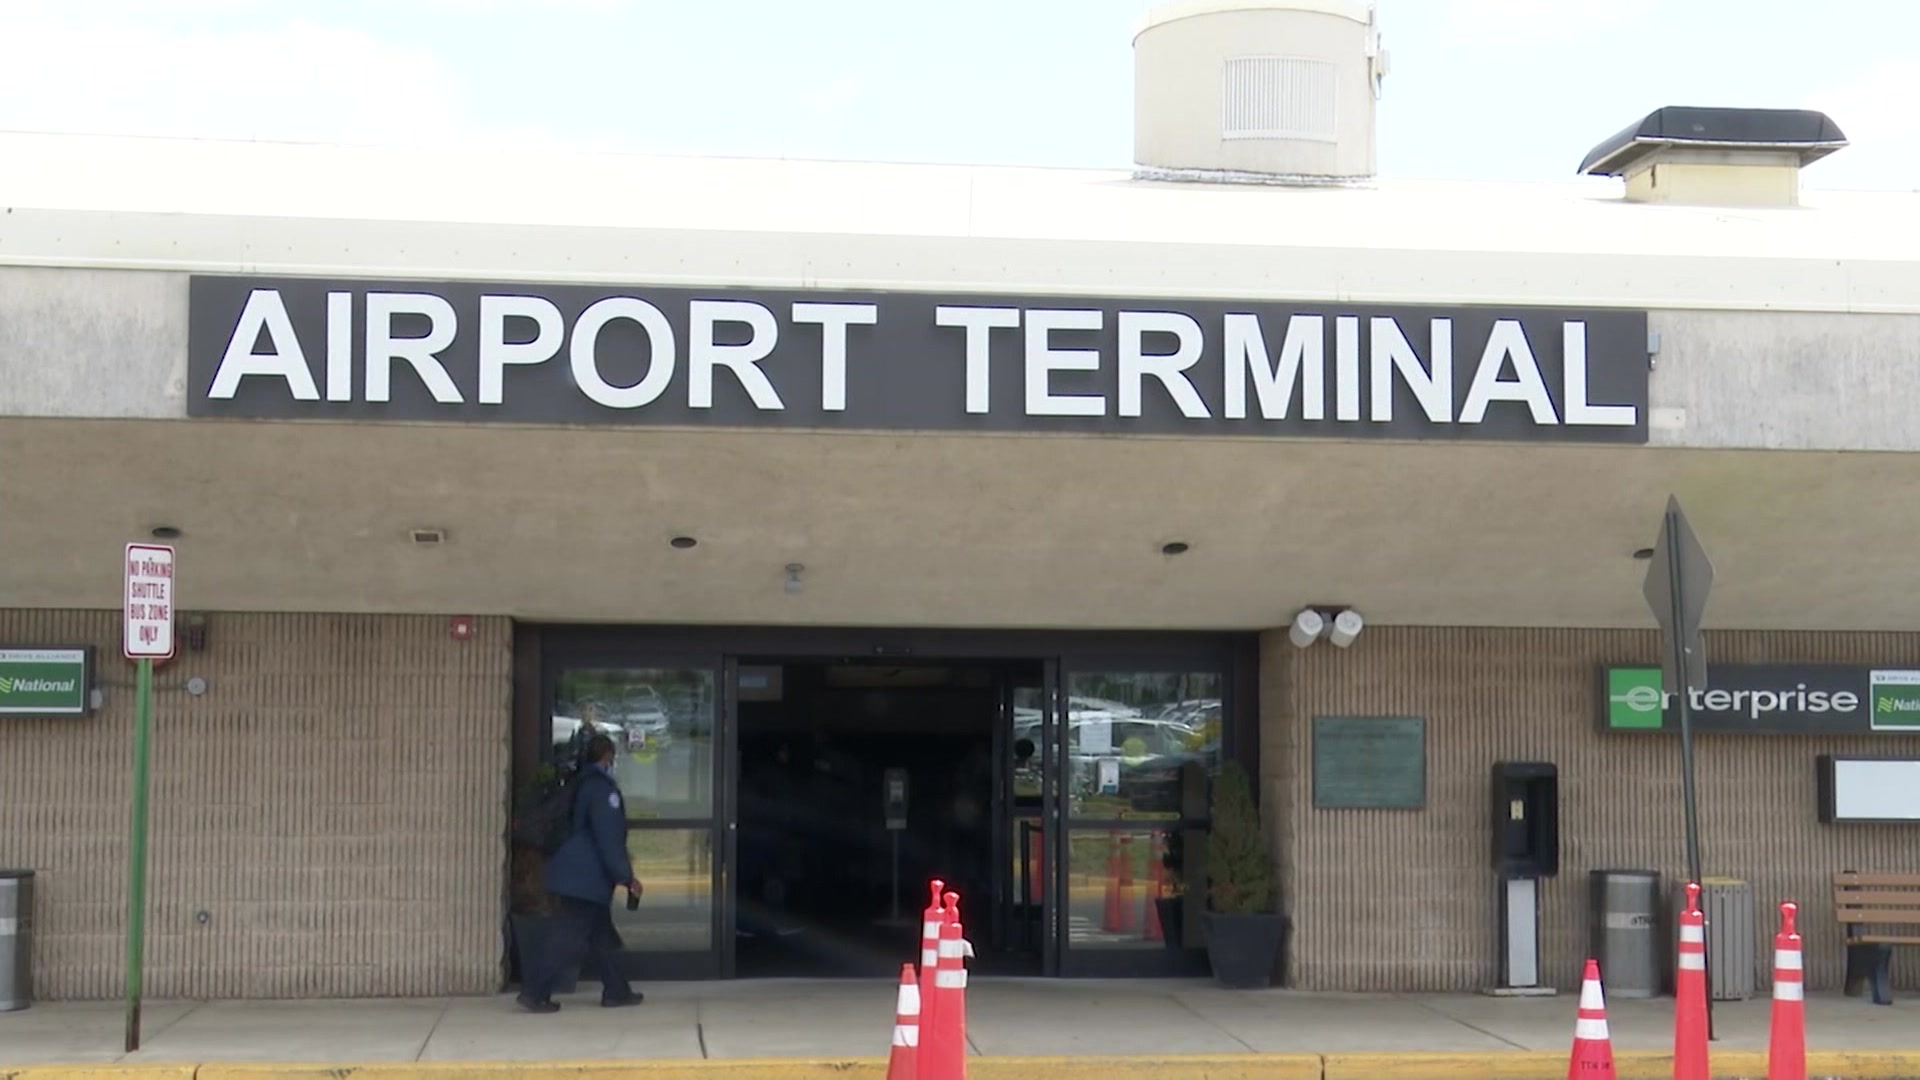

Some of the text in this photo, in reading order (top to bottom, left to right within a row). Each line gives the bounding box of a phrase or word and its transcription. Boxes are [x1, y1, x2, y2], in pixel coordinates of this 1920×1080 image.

[208, 288, 1637, 426] AIRPORT TERMINAL
[128, 560, 172, 578] NO PARKING
[132, 582, 165, 599] SHUTTLE
[130, 603, 168, 621] BUS ZONE
[139, 625, 158, 642] ONLY
[12, 678, 75, 692] National
